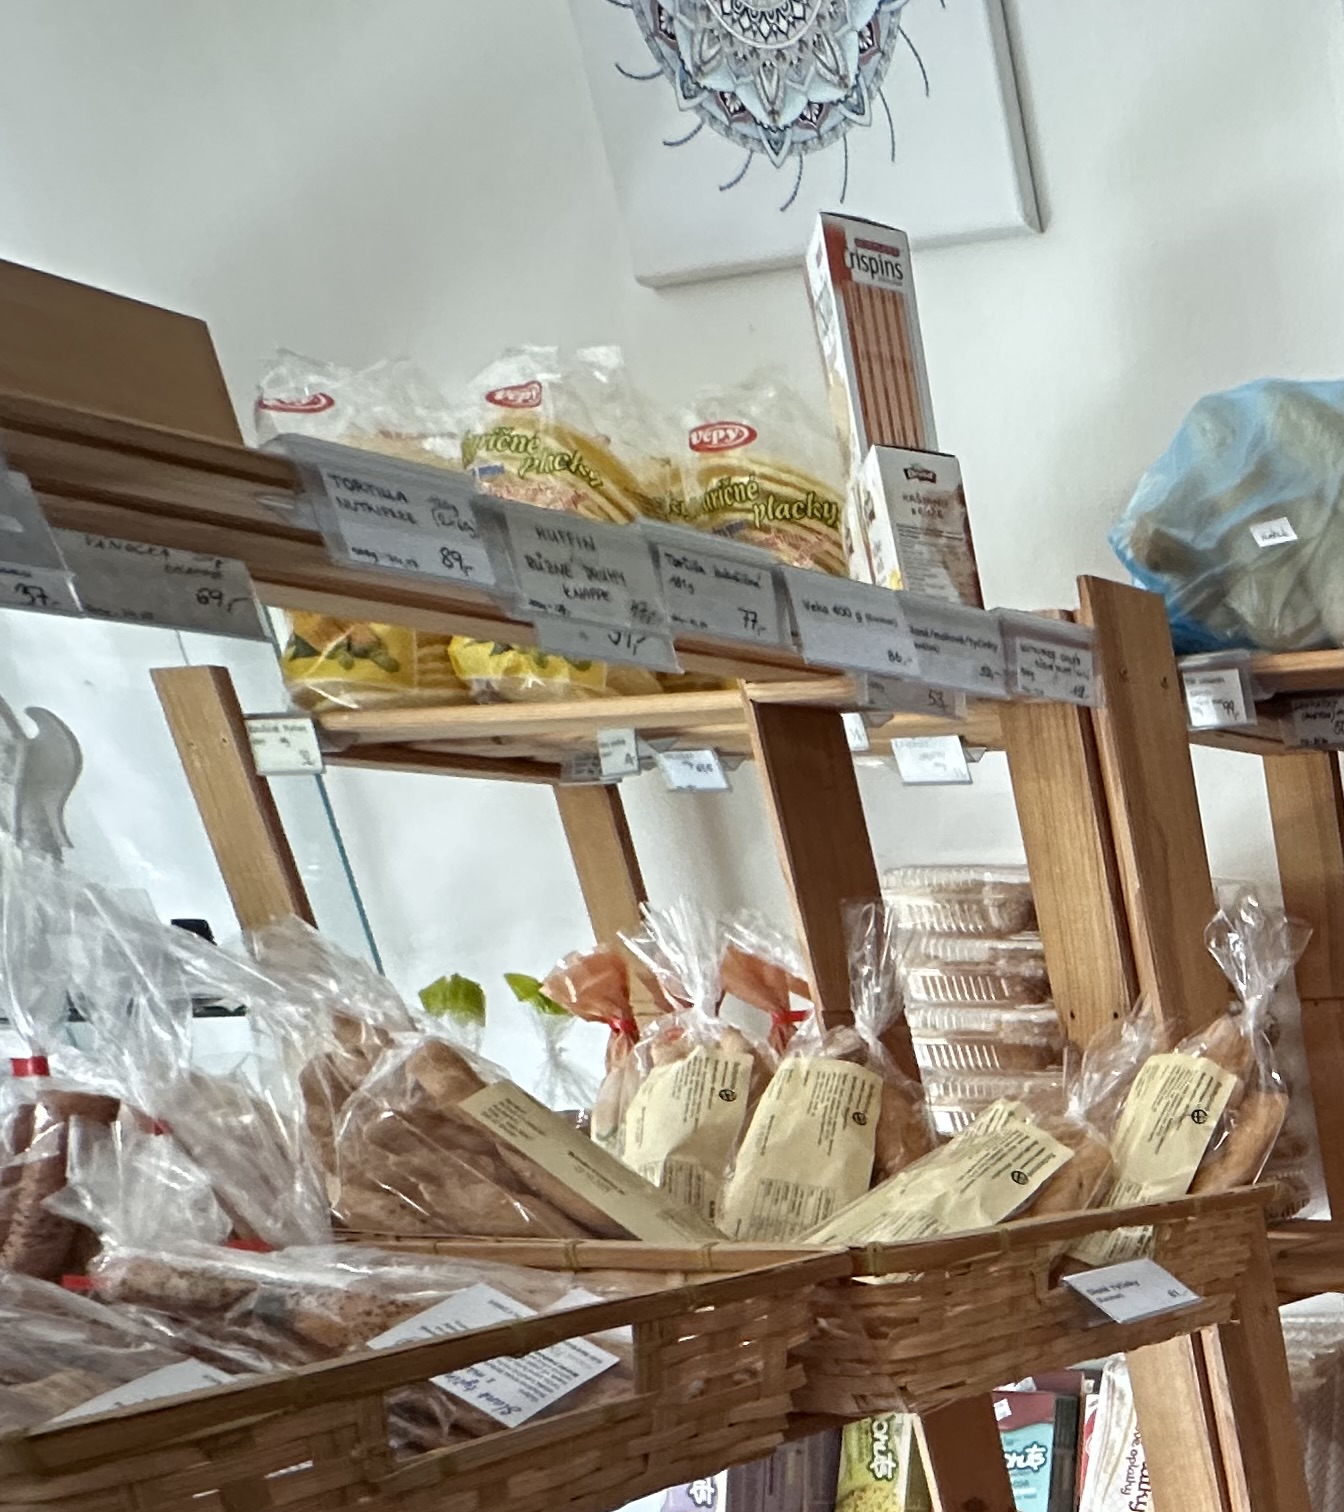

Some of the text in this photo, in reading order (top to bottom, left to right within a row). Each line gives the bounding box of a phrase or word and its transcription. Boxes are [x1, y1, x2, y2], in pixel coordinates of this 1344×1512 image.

[327, 474, 409, 503] TORTILLA
[752, 489, 841, 528] placky
[802, 599, 830, 616] Veka
[1120, 1448, 1141, 1497] oplatky
